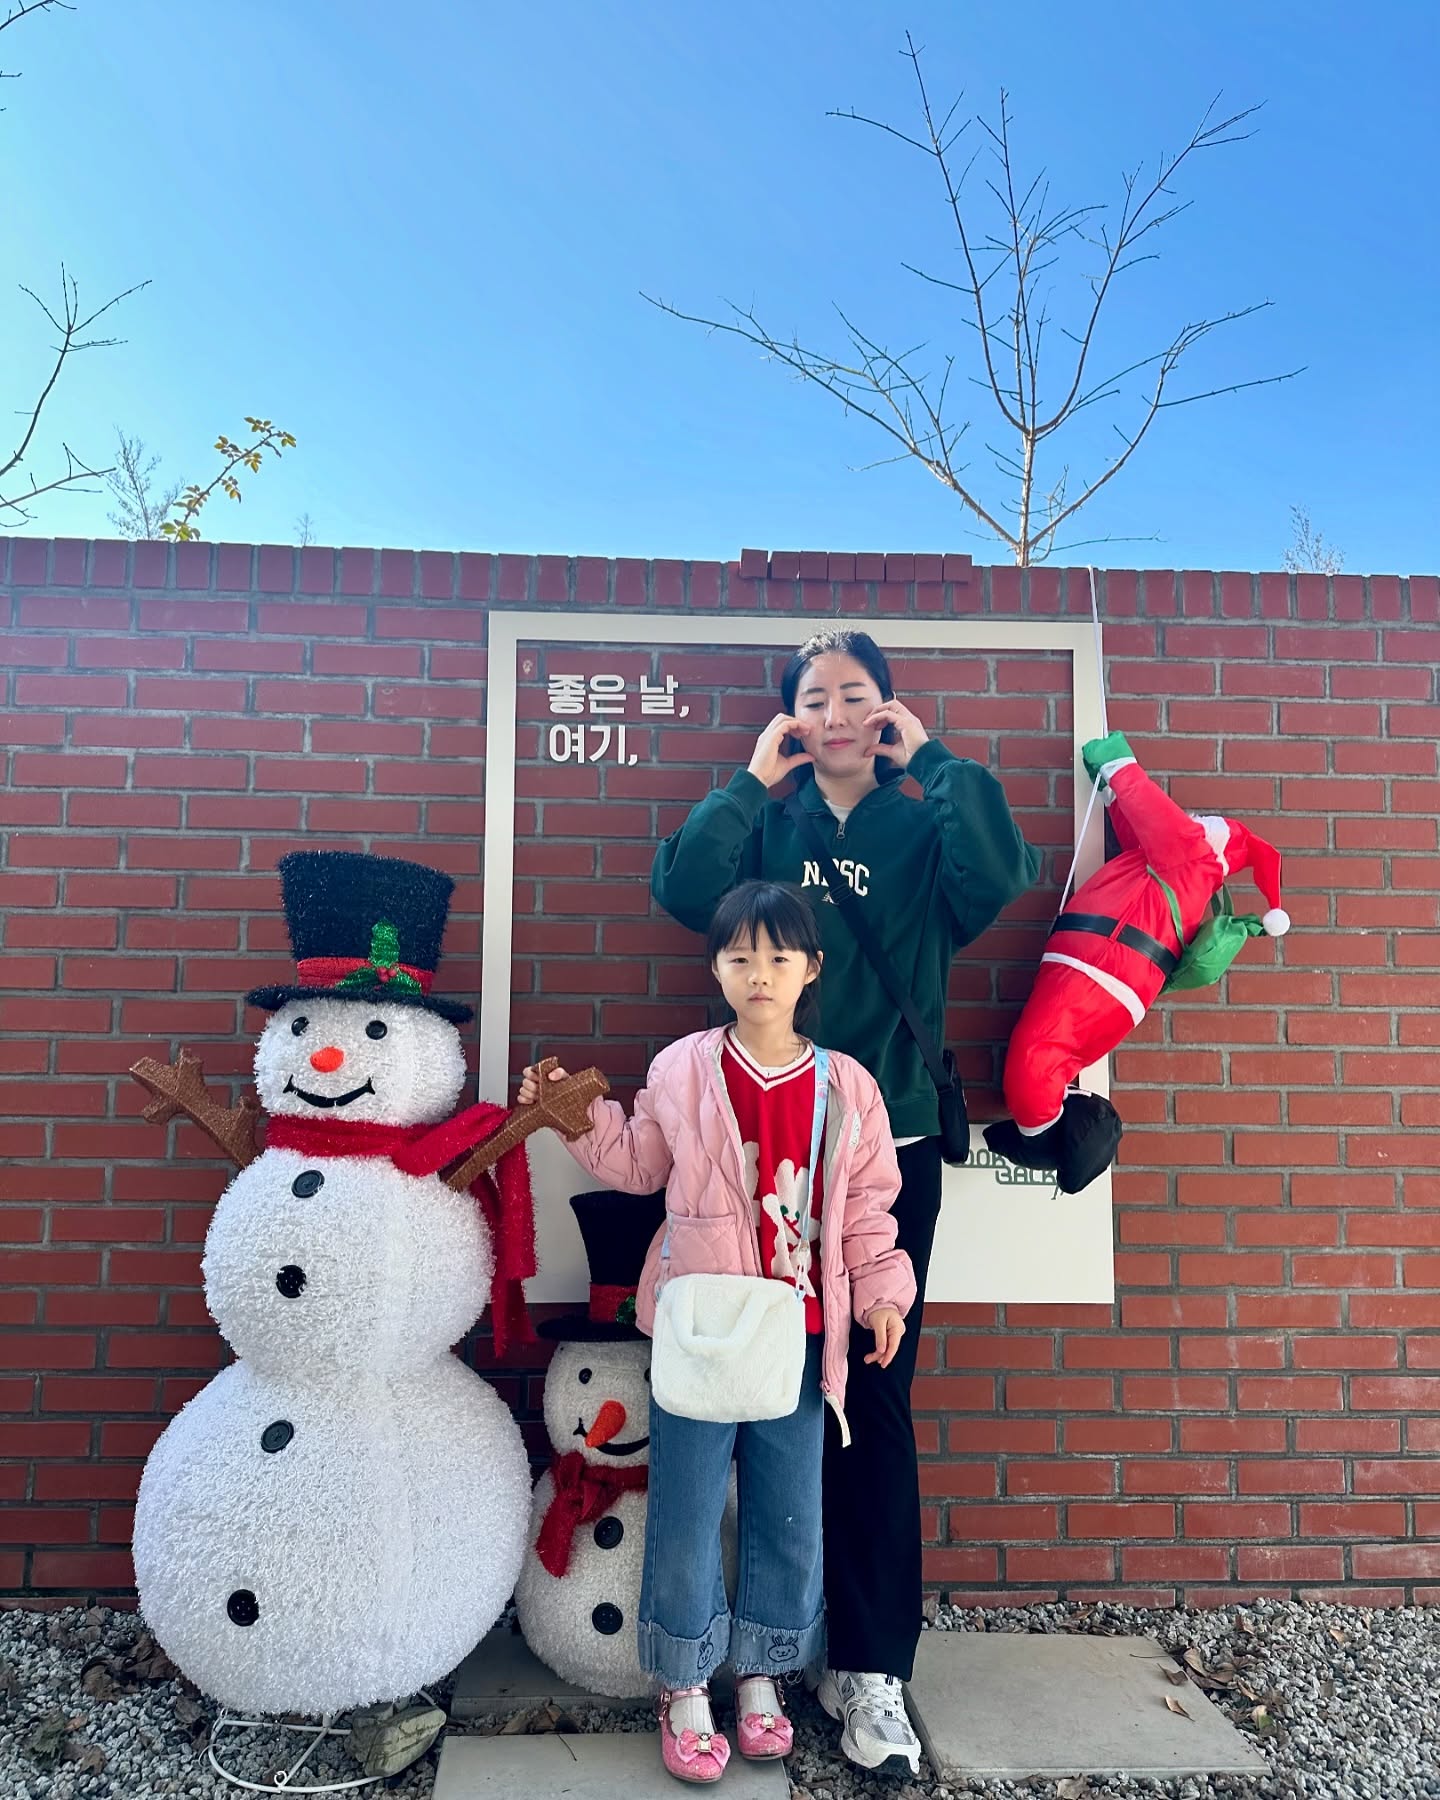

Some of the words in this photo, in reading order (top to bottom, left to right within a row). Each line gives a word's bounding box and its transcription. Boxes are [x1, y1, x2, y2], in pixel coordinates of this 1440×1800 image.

[547, 674, 627, 714] 좋은
[640, 674, 690, 718] 날,
[549, 724, 638, 766] 여기,
[801, 858, 870, 897] NSC
